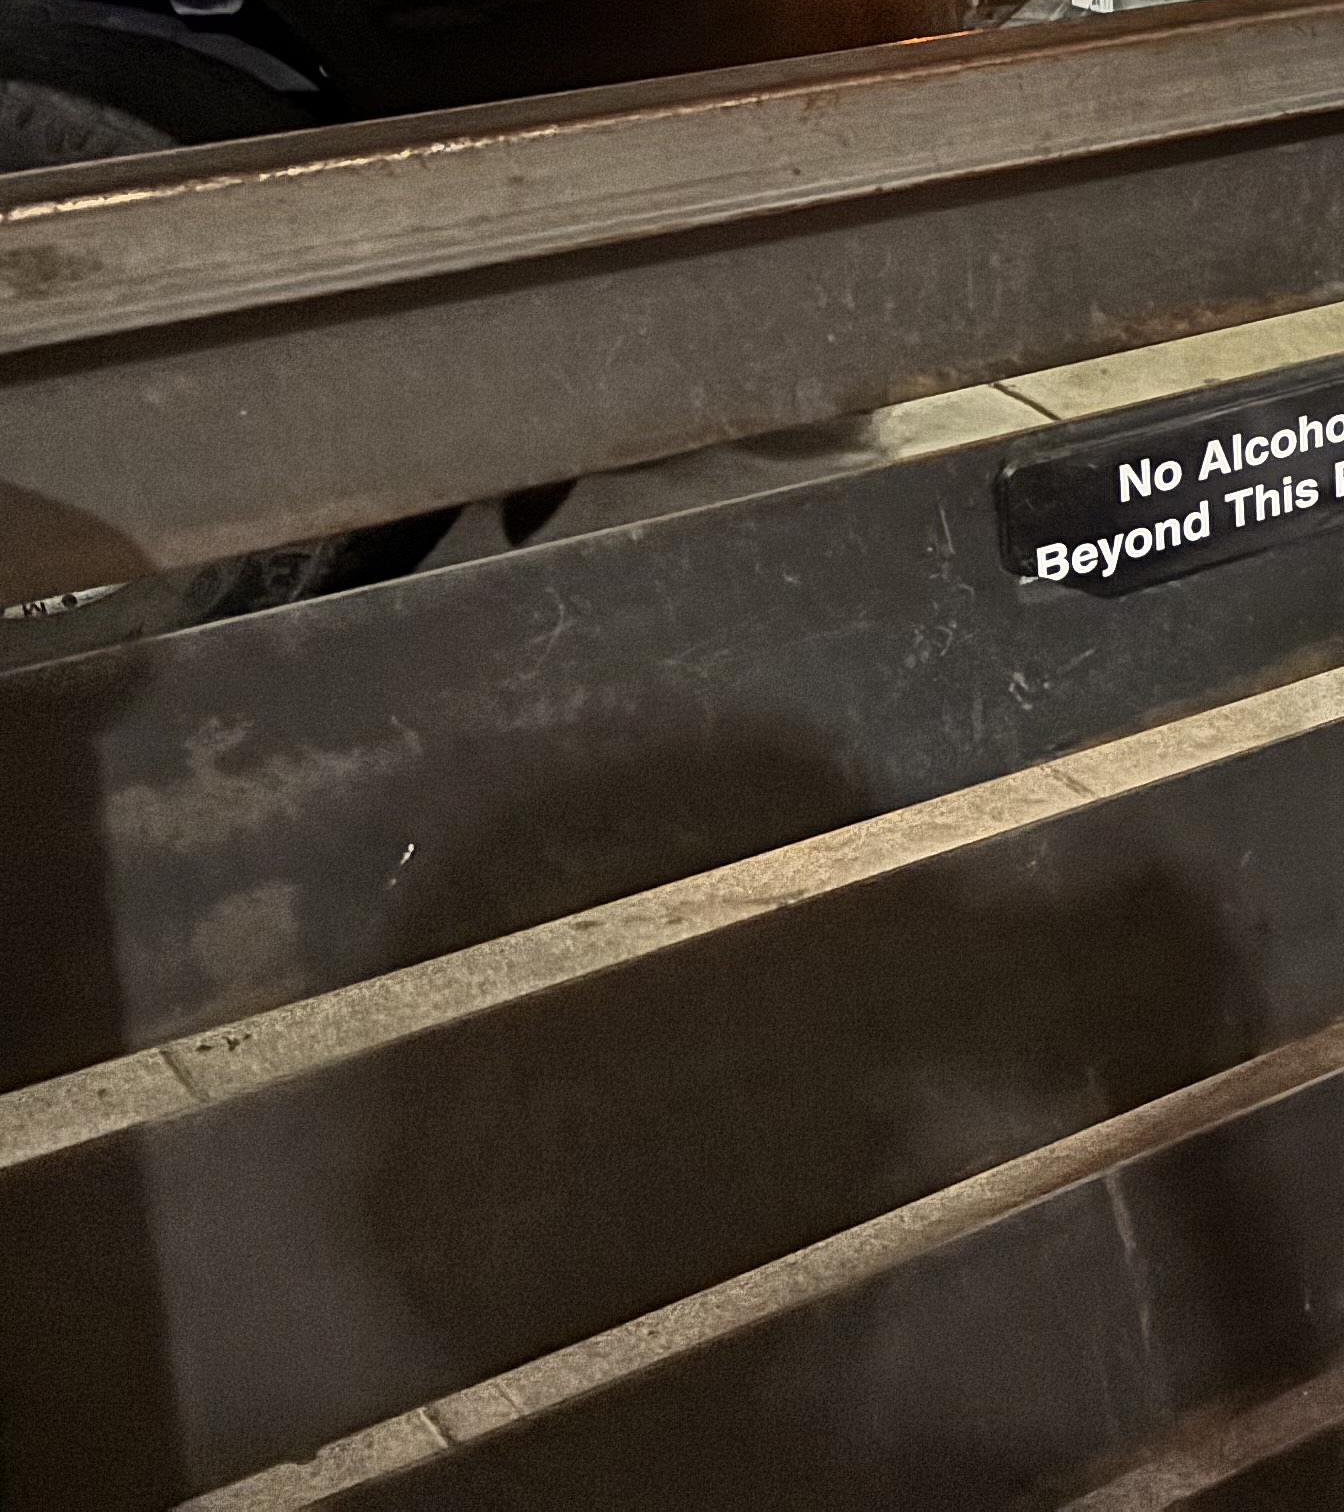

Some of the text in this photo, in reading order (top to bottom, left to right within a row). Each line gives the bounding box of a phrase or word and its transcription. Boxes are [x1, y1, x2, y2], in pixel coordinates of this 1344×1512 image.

[1119, 457, 1182, 503] No
[1036, 501, 1210, 582] Beyond
[1224, 475, 1319, 528] This
